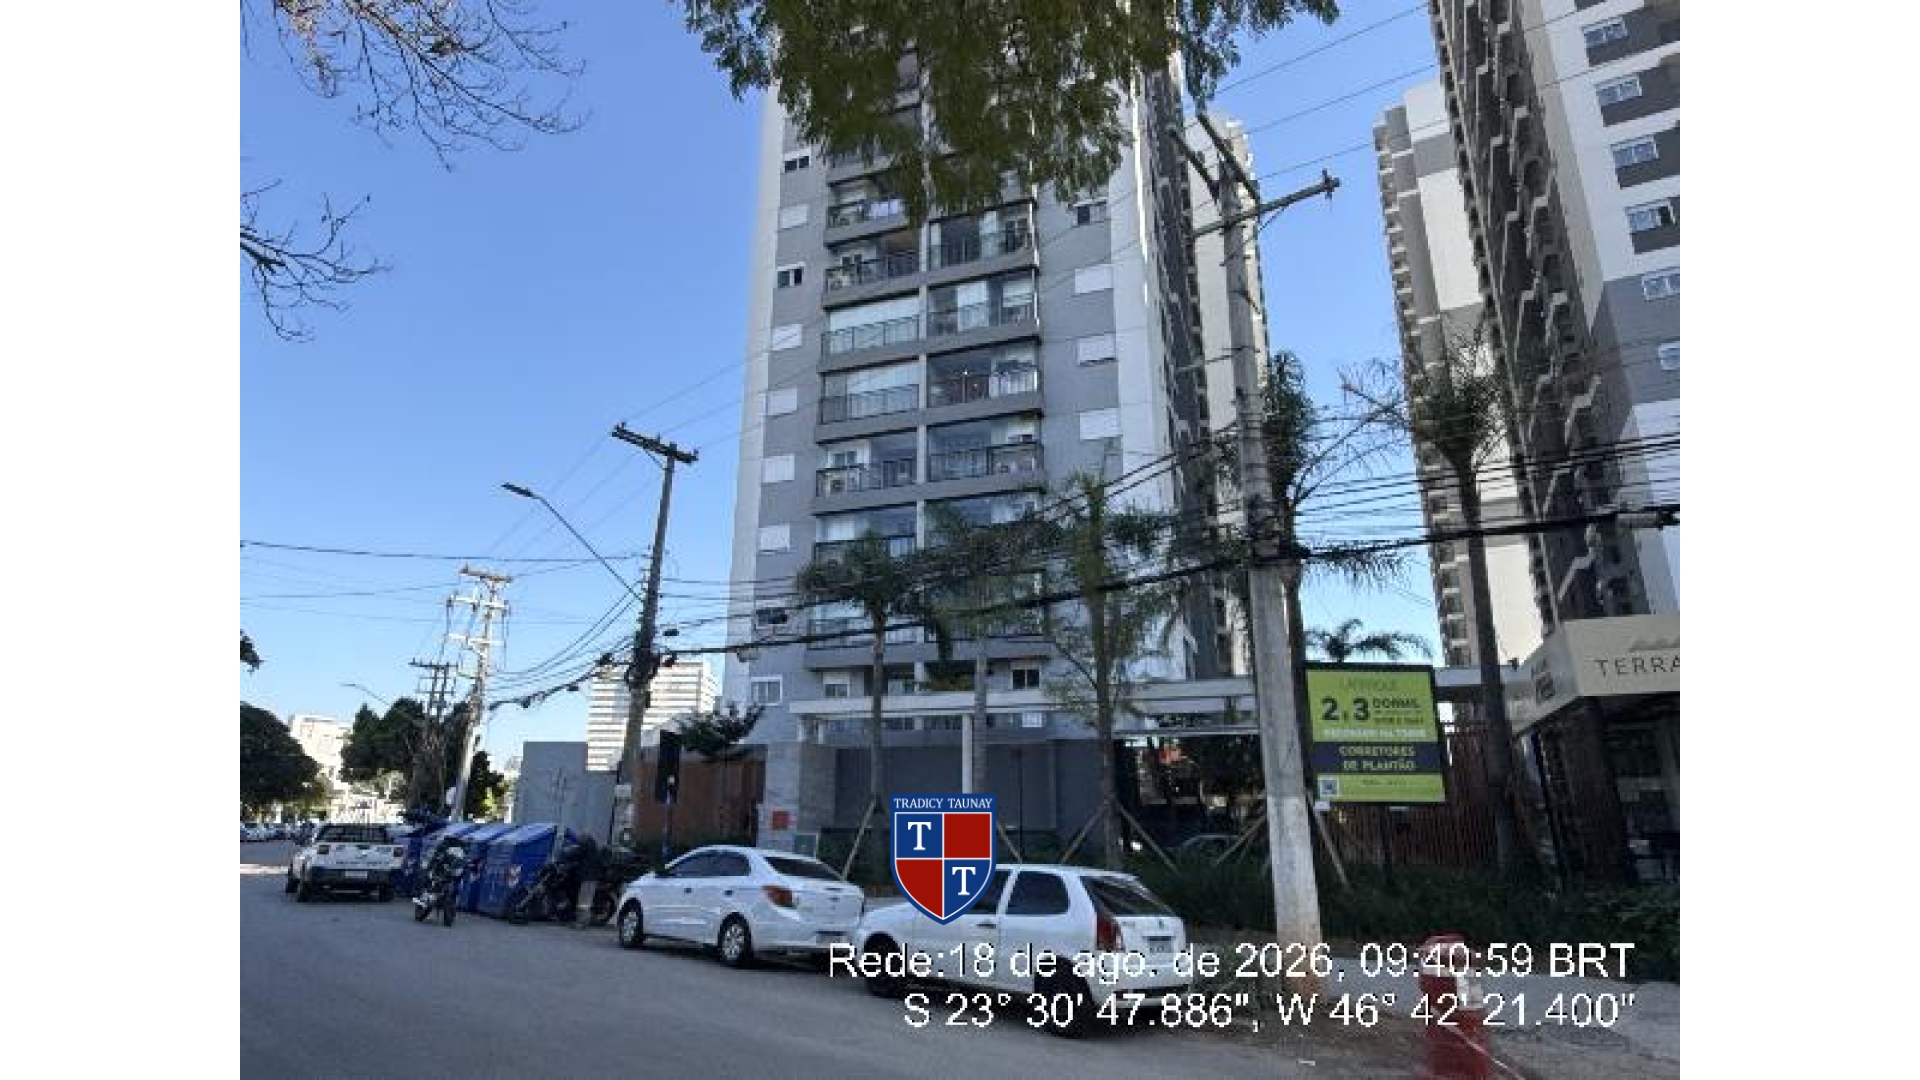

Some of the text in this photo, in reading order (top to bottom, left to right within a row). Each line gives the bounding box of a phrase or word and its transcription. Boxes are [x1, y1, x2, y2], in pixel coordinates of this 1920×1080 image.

[1339, 745, 1415, 757] CORRETORES
[1344, 757, 1415, 771] DE PLANTÃO
